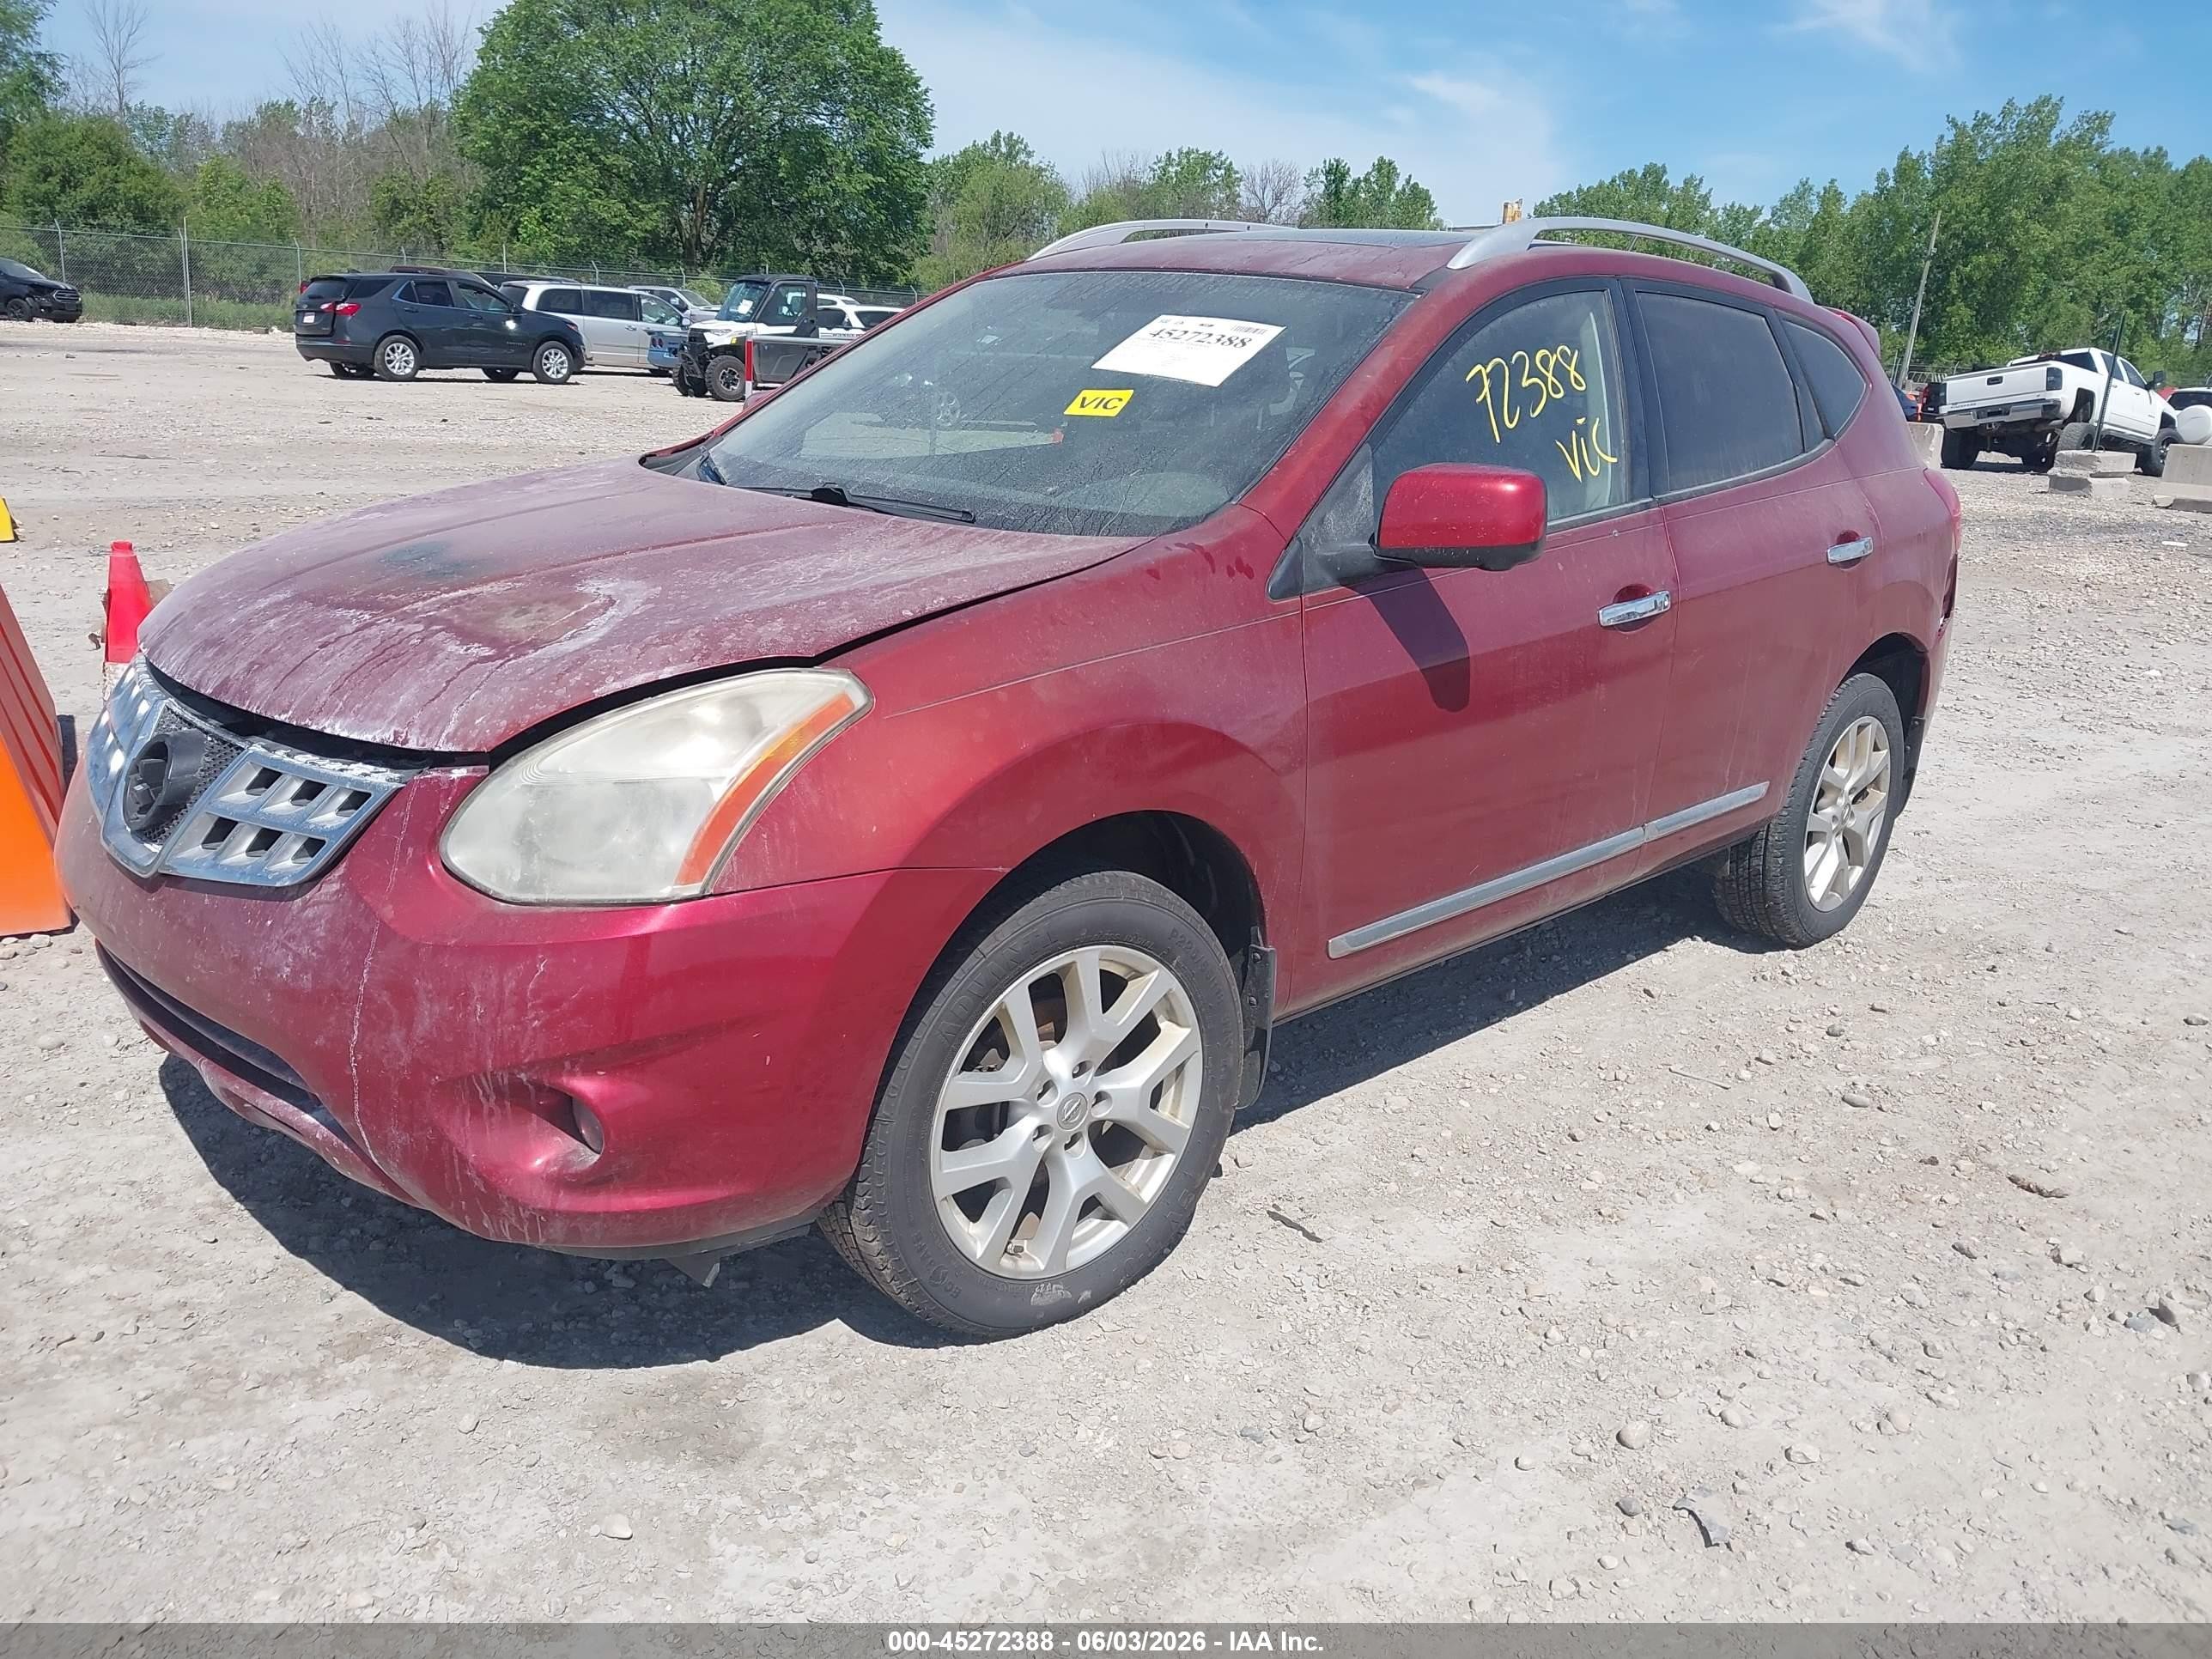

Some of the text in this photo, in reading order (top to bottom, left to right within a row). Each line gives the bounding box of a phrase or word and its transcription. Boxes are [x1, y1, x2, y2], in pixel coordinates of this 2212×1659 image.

[1149, 328, 1253, 349] 45272388
[1079, 396, 1123, 410] VIC
[1465, 344, 1587, 444] 72388
